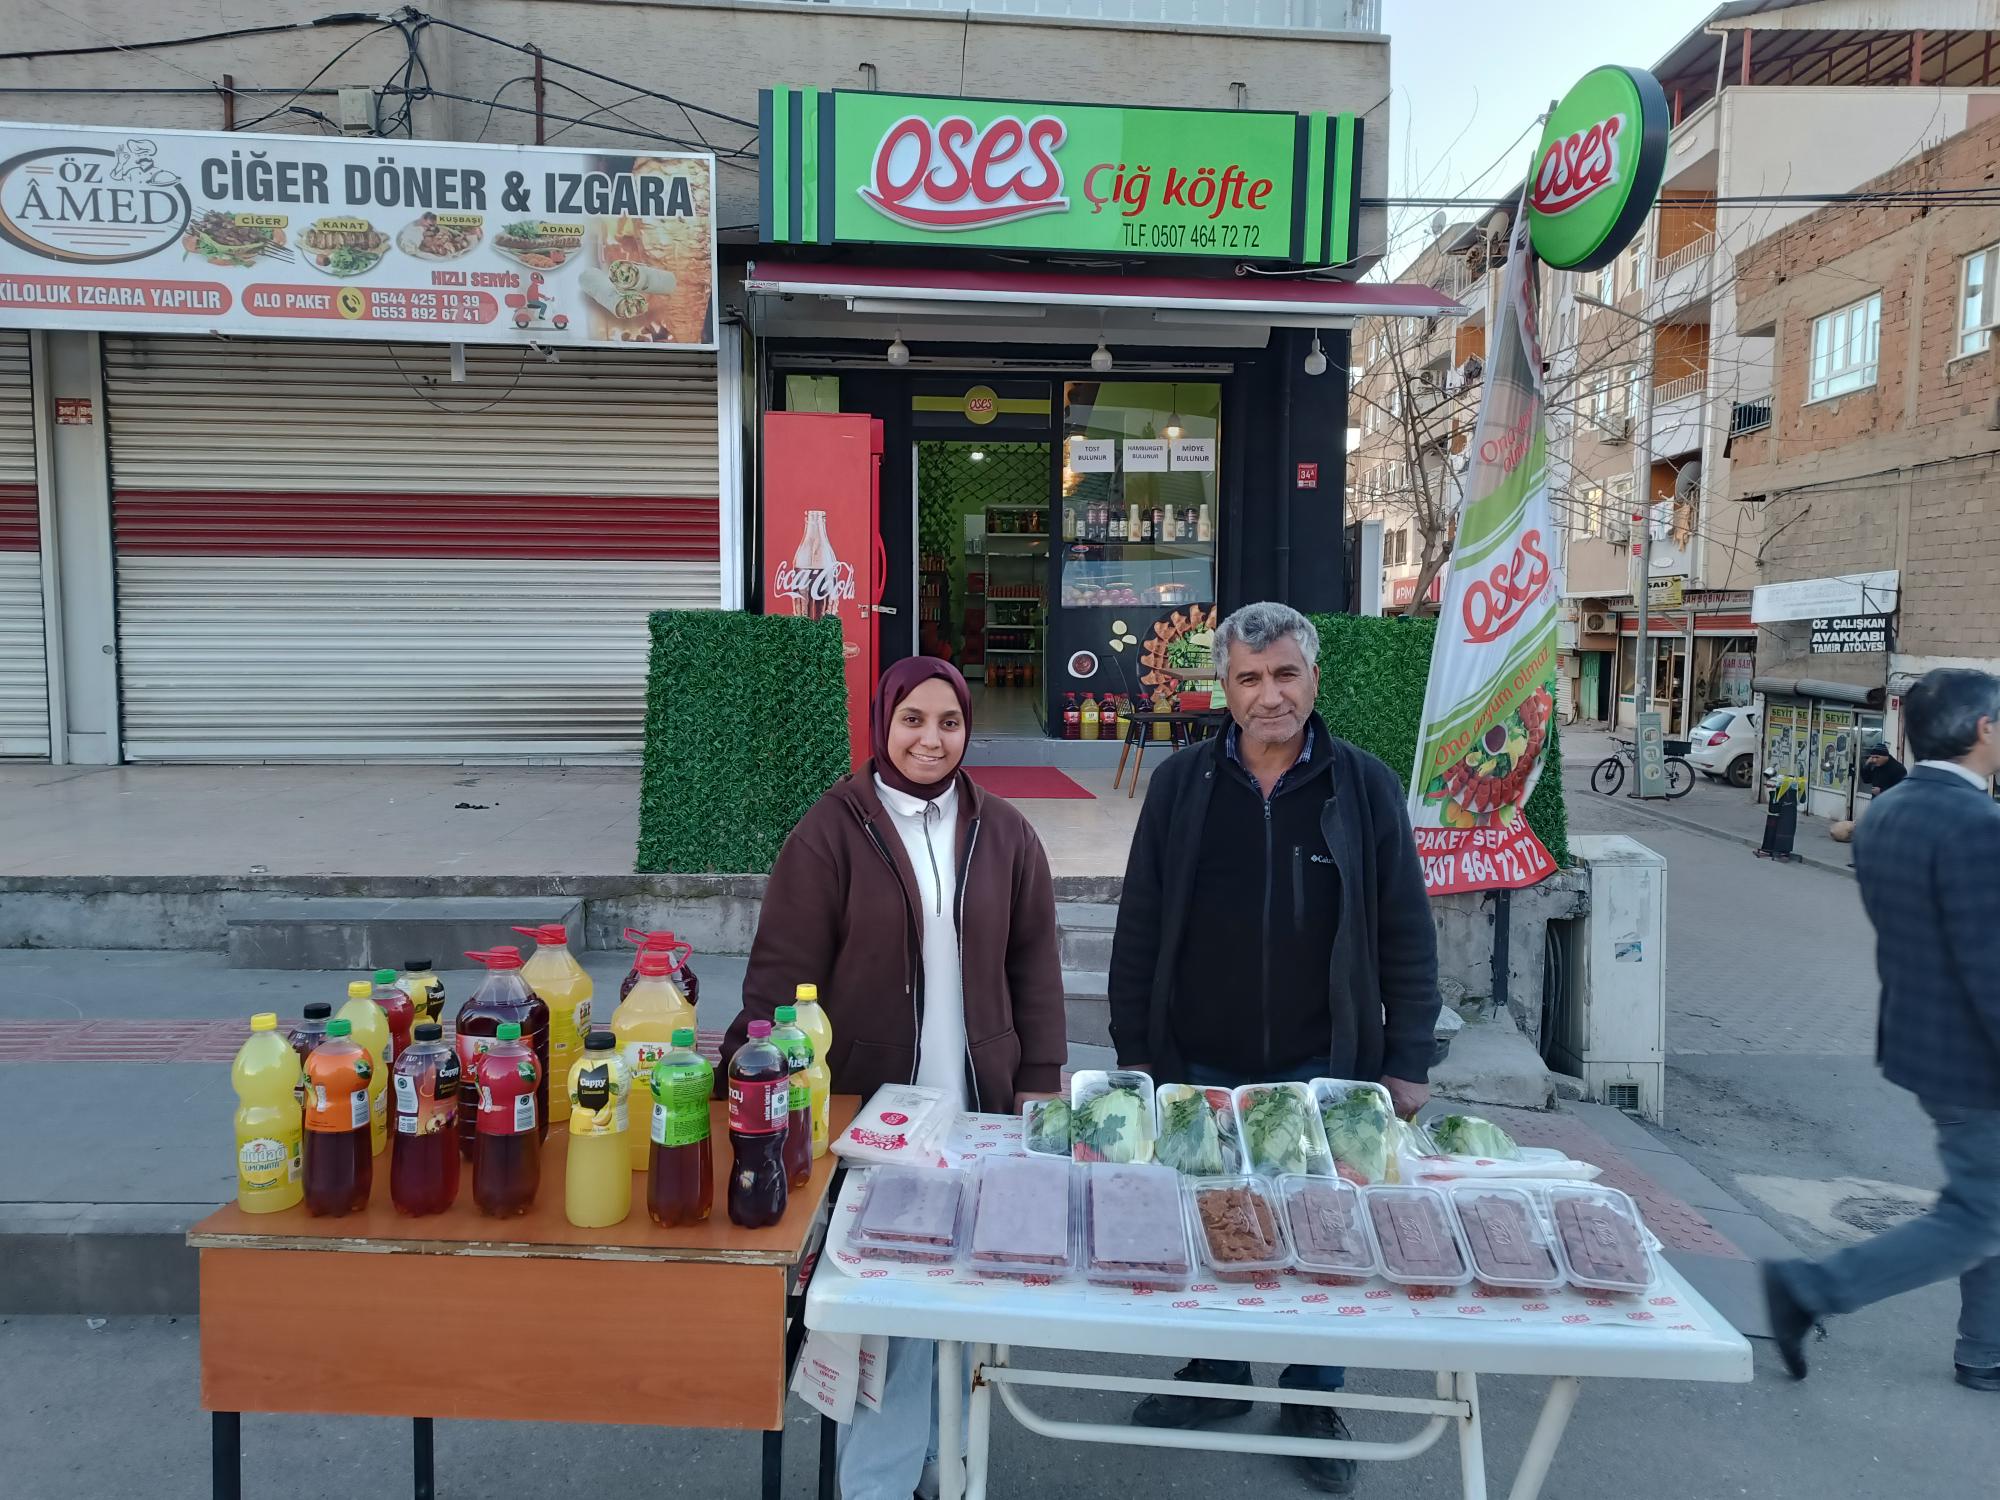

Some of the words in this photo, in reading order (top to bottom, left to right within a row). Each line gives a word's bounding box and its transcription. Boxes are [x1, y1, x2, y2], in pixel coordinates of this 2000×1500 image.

[59, 157, 103, 184] ÖZ
[201, 150, 329, 204] CİĞER
[344, 157, 486, 210] DÖNER
[501, 170, 531, 212] &
[545, 172, 694, 217] IZGARA
[1083, 163, 1151, 217] Çiğ
[1162, 164, 1273, 219] köfte
[16, 178, 178, 225] ÂMED
[242, 215, 281, 225] CİĞER
[323, 221, 365, 230] KANAT
[542, 226, 581, 234] ADANA
[1123, 223, 1149, 247] TLF.
[1152, 225, 1186, 247] 0507
[1190, 225, 1217, 247] 464
[1221, 225, 1238, 248] 72
[1243, 225, 1260, 248] 72
[432, 271, 467, 287] HIZLI
[471, 270, 520, 288] SERVİS
[0, 280, 72, 303] KİLOLUK
[77, 284, 145, 306] IZGARA
[151, 288, 221, 309] YAPILIR
[253, 293, 281, 308] ALO
[286, 294, 331, 310] PAKET
[371, 292, 406, 305] 0544
[411, 293, 436, 305] 425
[442, 294, 458, 306] 10
[463, 295, 480, 307] 39
[372, 306, 407, 319] 0553
[411, 307, 437, 320] 892
[442, 308, 458, 321] 67
[463, 309, 480, 321] 41
[773, 560, 855, 601] Coca-Cola
[1812, 618, 1829, 630] ÖZ
[1833, 618, 1886, 630] ÇALIŞKAN
[1811, 631, 1885, 642] AYAKKABI
[1812, 643, 1841, 653] TAMİR
[1843, 641, 1886, 653] ATÖLYESİ
[1771, 708, 1793, 718] SEYİT
[1825, 713, 1849, 723] SEYİT
[1435, 731, 1471, 766] Ona
[1415, 830, 1470, 850] PAKET
[1461, 850, 1498, 882] 464
[1495, 848, 1526, 881] 72
[1514, 836, 1547, 874] 72
[580, 1078, 606, 1088] Cappy
